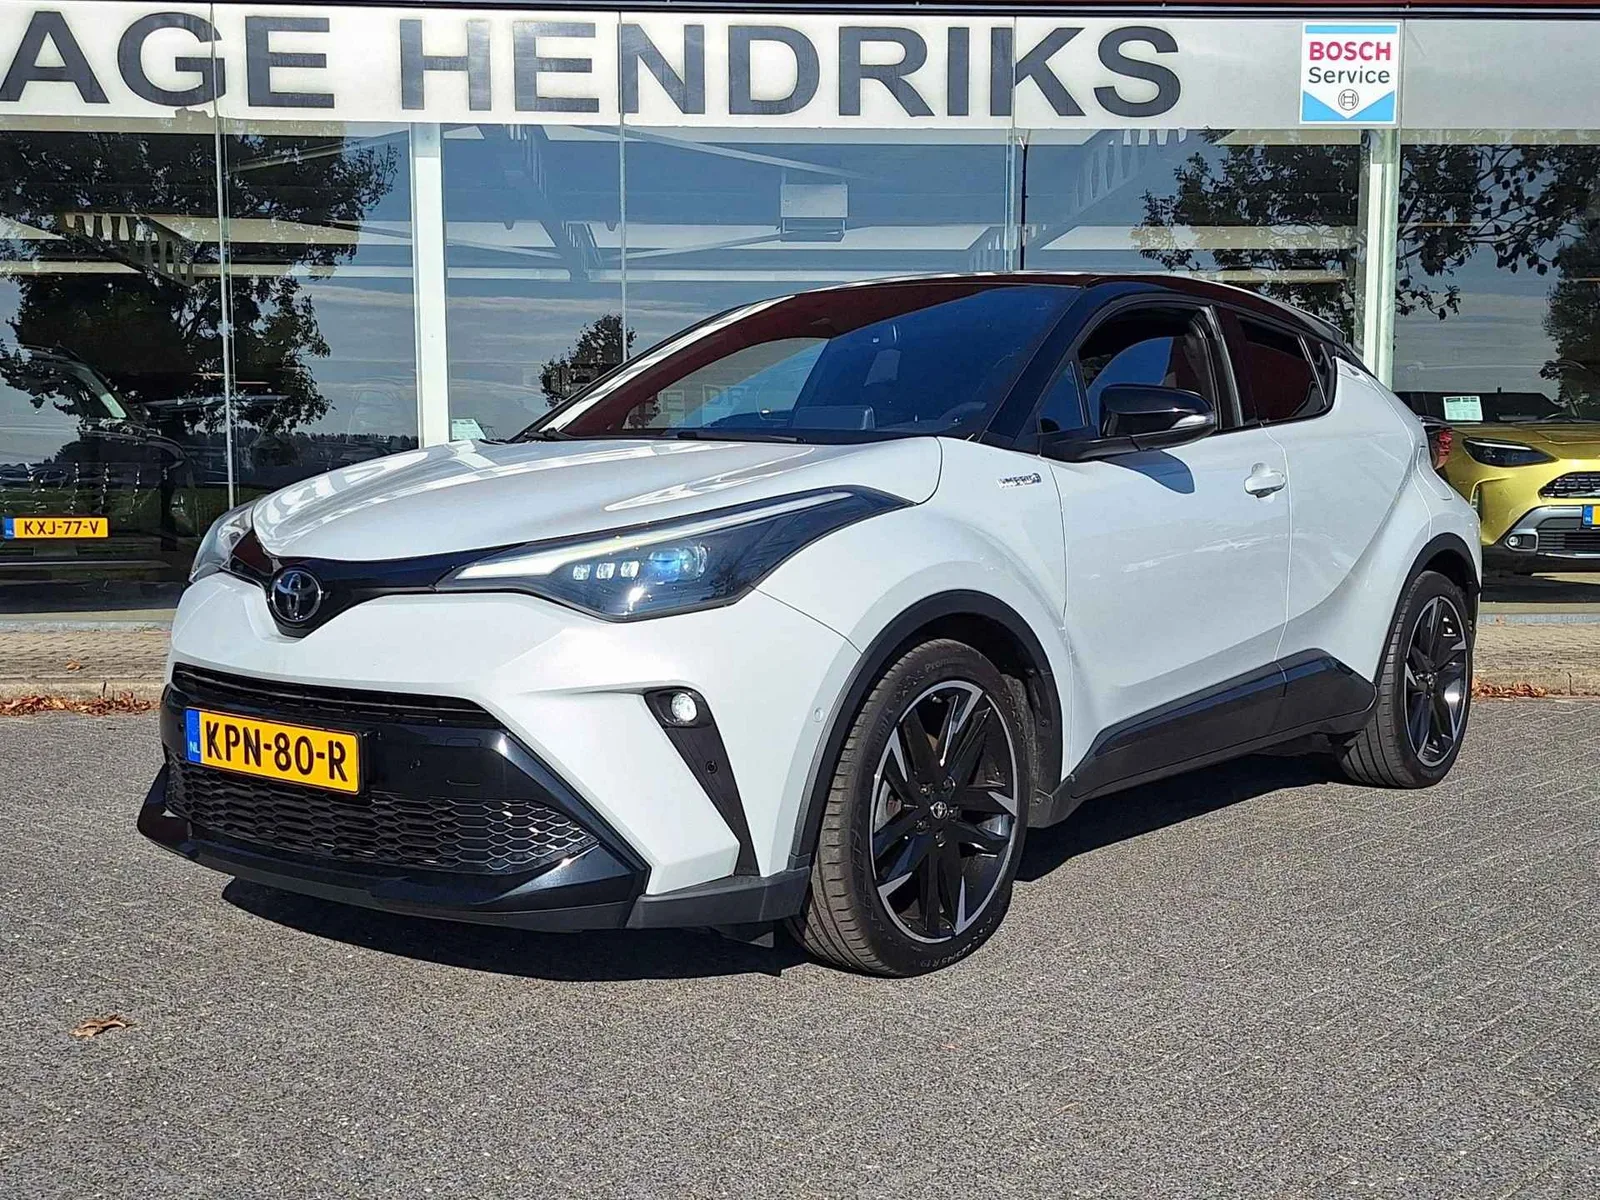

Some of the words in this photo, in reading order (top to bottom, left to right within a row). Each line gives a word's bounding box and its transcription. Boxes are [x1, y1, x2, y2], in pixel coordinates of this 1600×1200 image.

[1309, 41, 1391, 61] BOSCH
[0, 11, 335, 108] AGE
[400, 19, 1182, 118] HENDRIKS
[1308, 65, 1390, 84] Service
[24, 520, 99, 535] KXJ-77-V
[189, 741, 200, 754] NL
[205, 720, 348, 782] KPN-80-R
